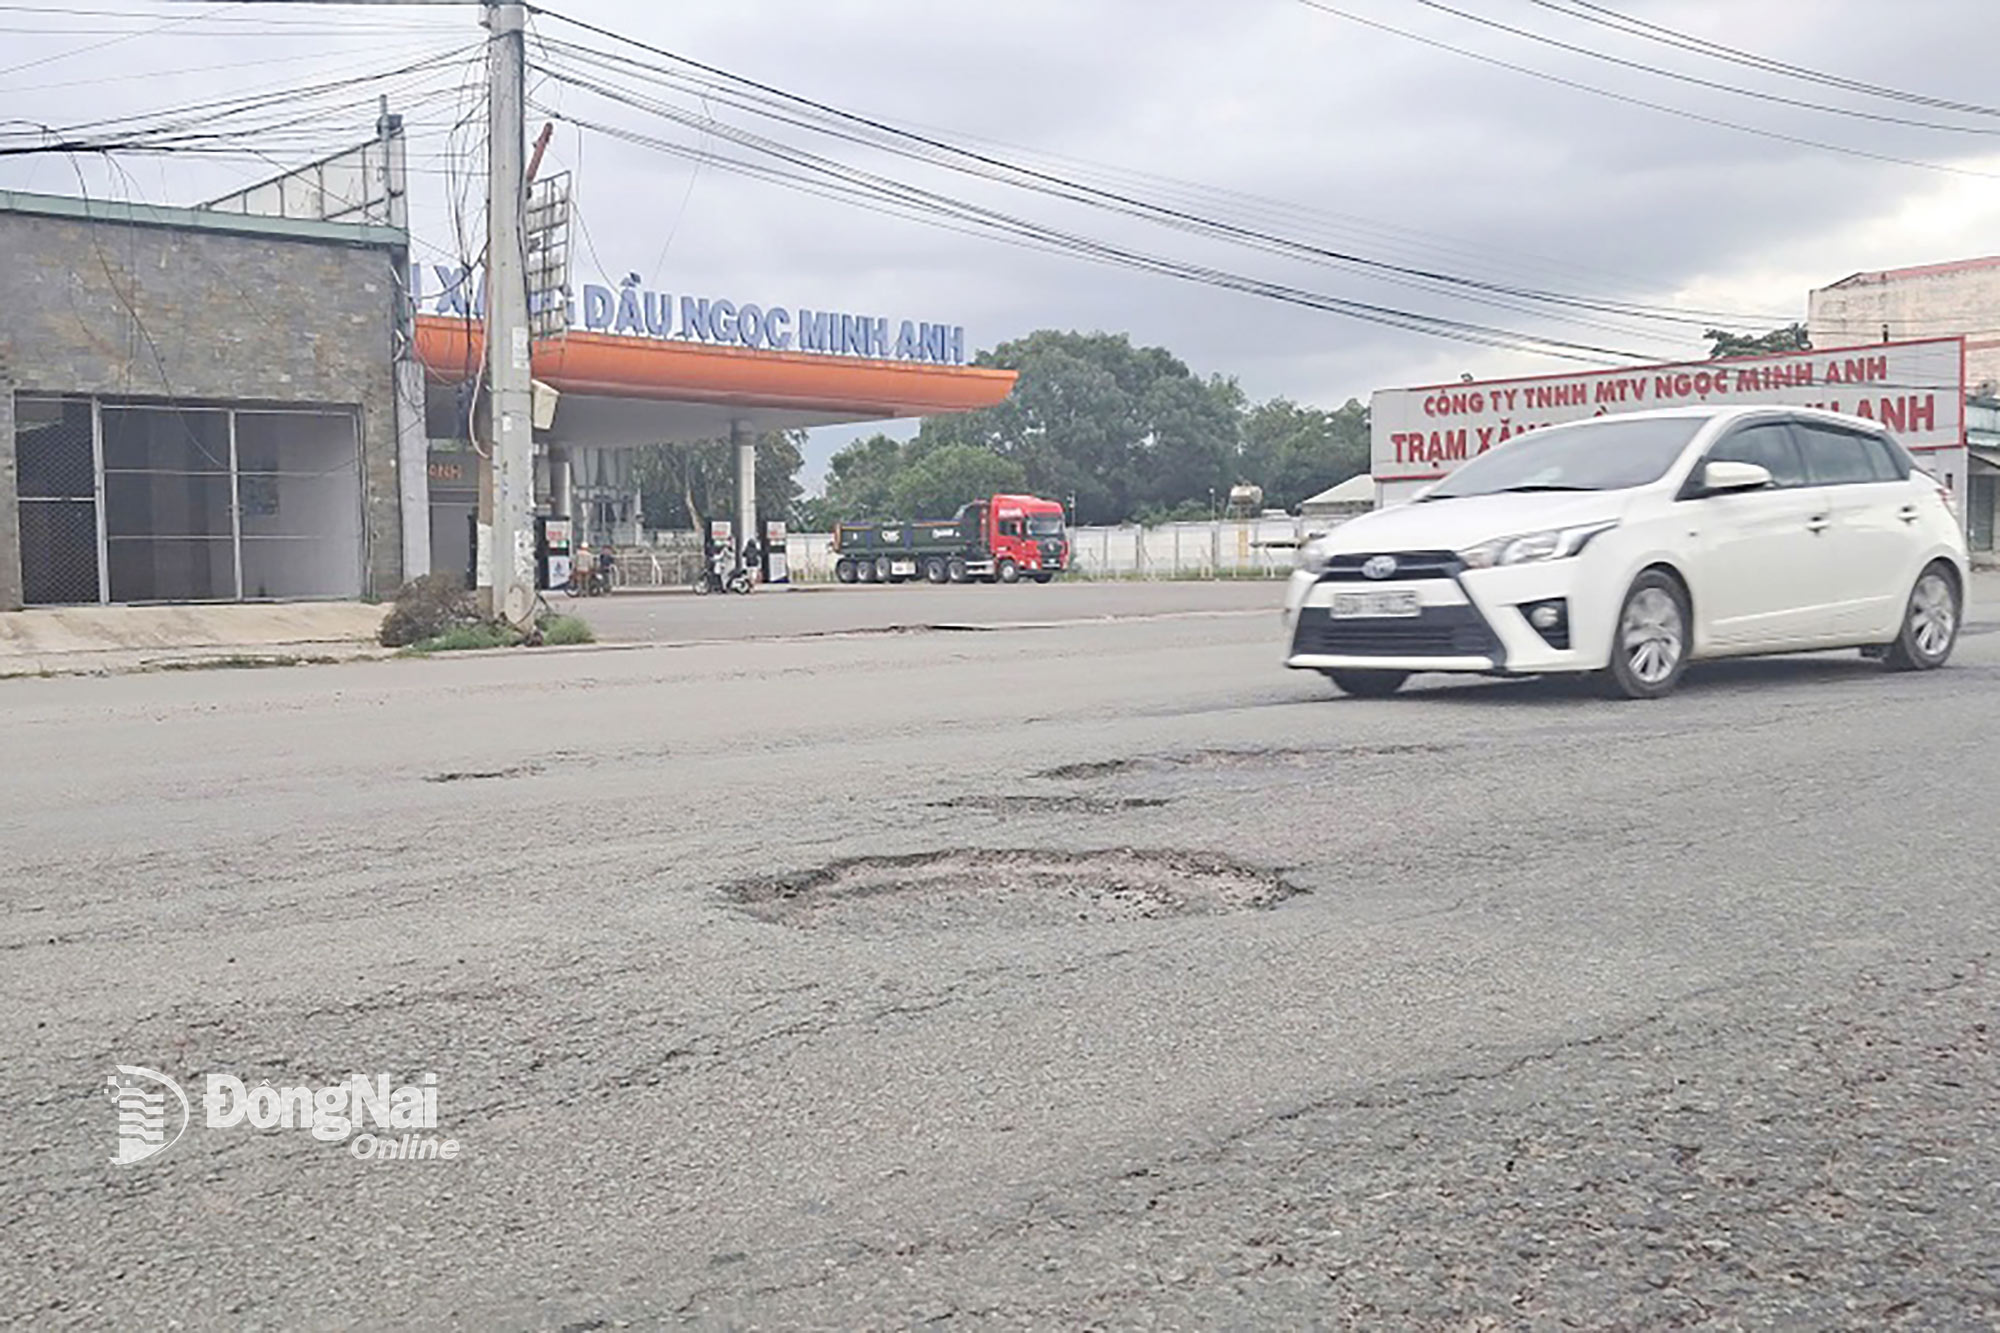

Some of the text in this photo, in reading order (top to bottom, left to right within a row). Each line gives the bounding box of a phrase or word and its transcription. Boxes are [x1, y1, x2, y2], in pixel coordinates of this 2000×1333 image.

[799, 309, 888, 356] MINH
[896, 319, 964, 363] ANH
[1424, 355, 1887, 418] CÔNG TY TNHH MTV NGỌC MINH ANH
[1391, 428, 1467, 469] TRẠM
